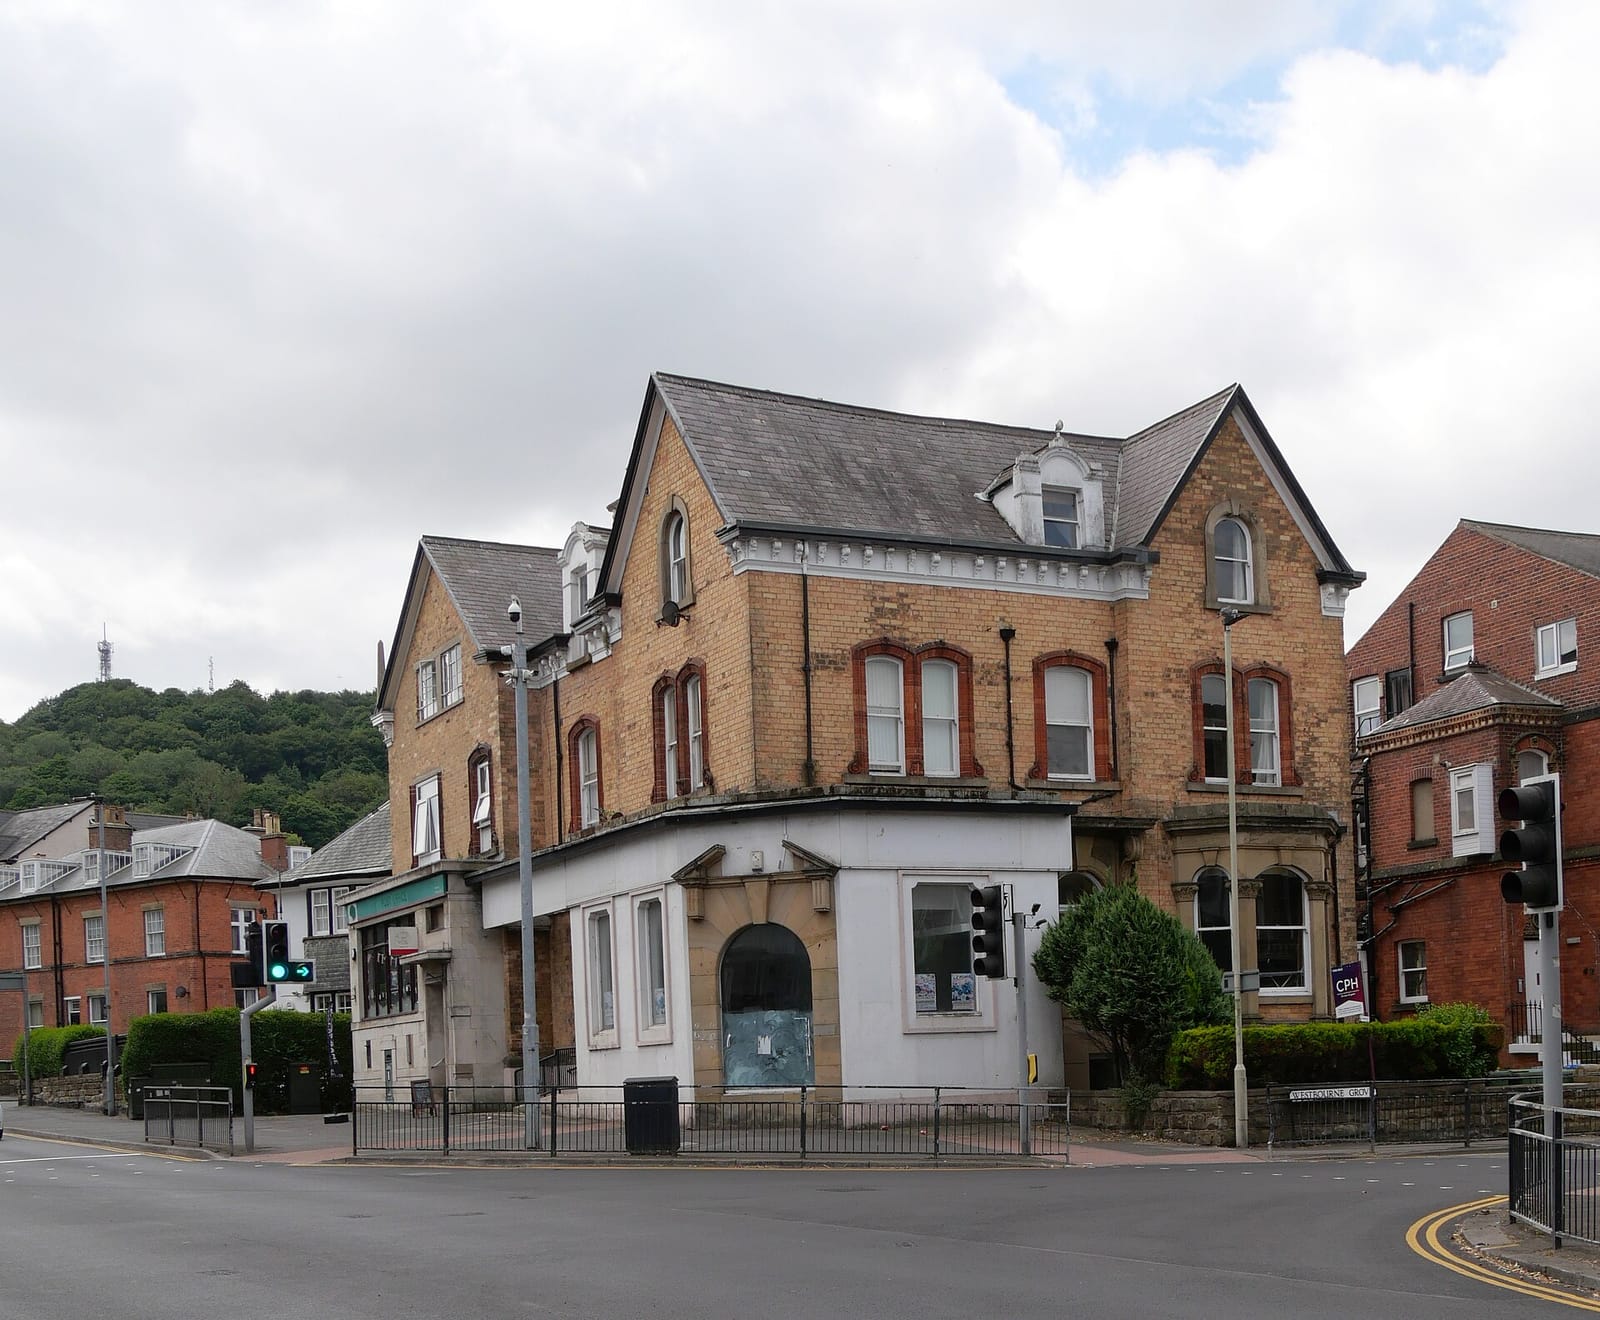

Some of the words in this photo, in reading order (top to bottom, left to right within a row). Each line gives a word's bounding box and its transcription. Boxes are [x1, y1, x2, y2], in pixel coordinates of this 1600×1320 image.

[1336, 977, 1359, 992] CPH
[1292, 1089, 1344, 1099] WESTBOURNE
[1348, 1088, 1369, 1096] GROV
